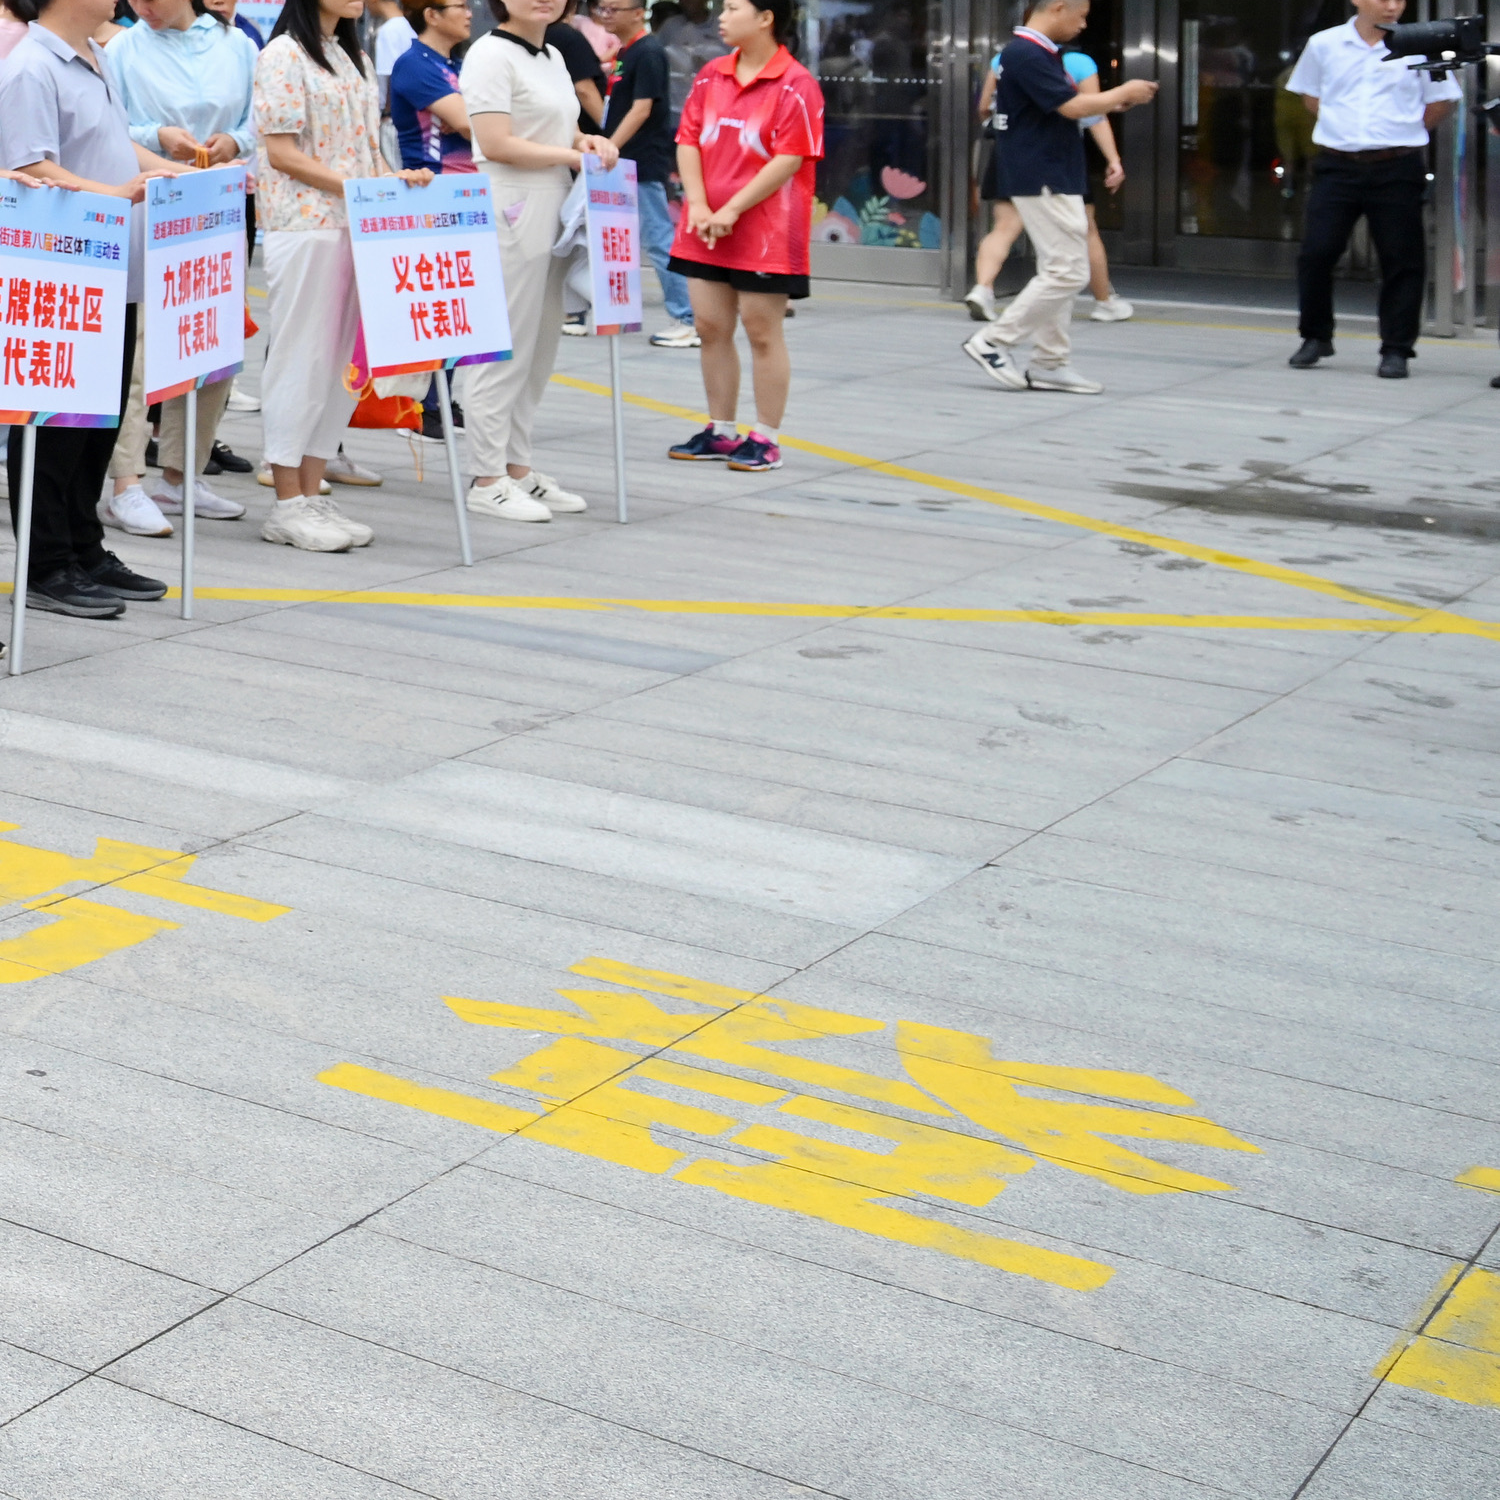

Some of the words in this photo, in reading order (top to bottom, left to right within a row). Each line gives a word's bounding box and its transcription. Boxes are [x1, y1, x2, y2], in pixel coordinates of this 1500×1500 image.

[163, 252, 233, 309] 九狮桥社区
[392, 250, 475, 293] 义仓社区
[178, 307, 218, 360] 代表队
[410, 298, 472, 341] 代表队
[3, 337, 75, 389] 代表队
